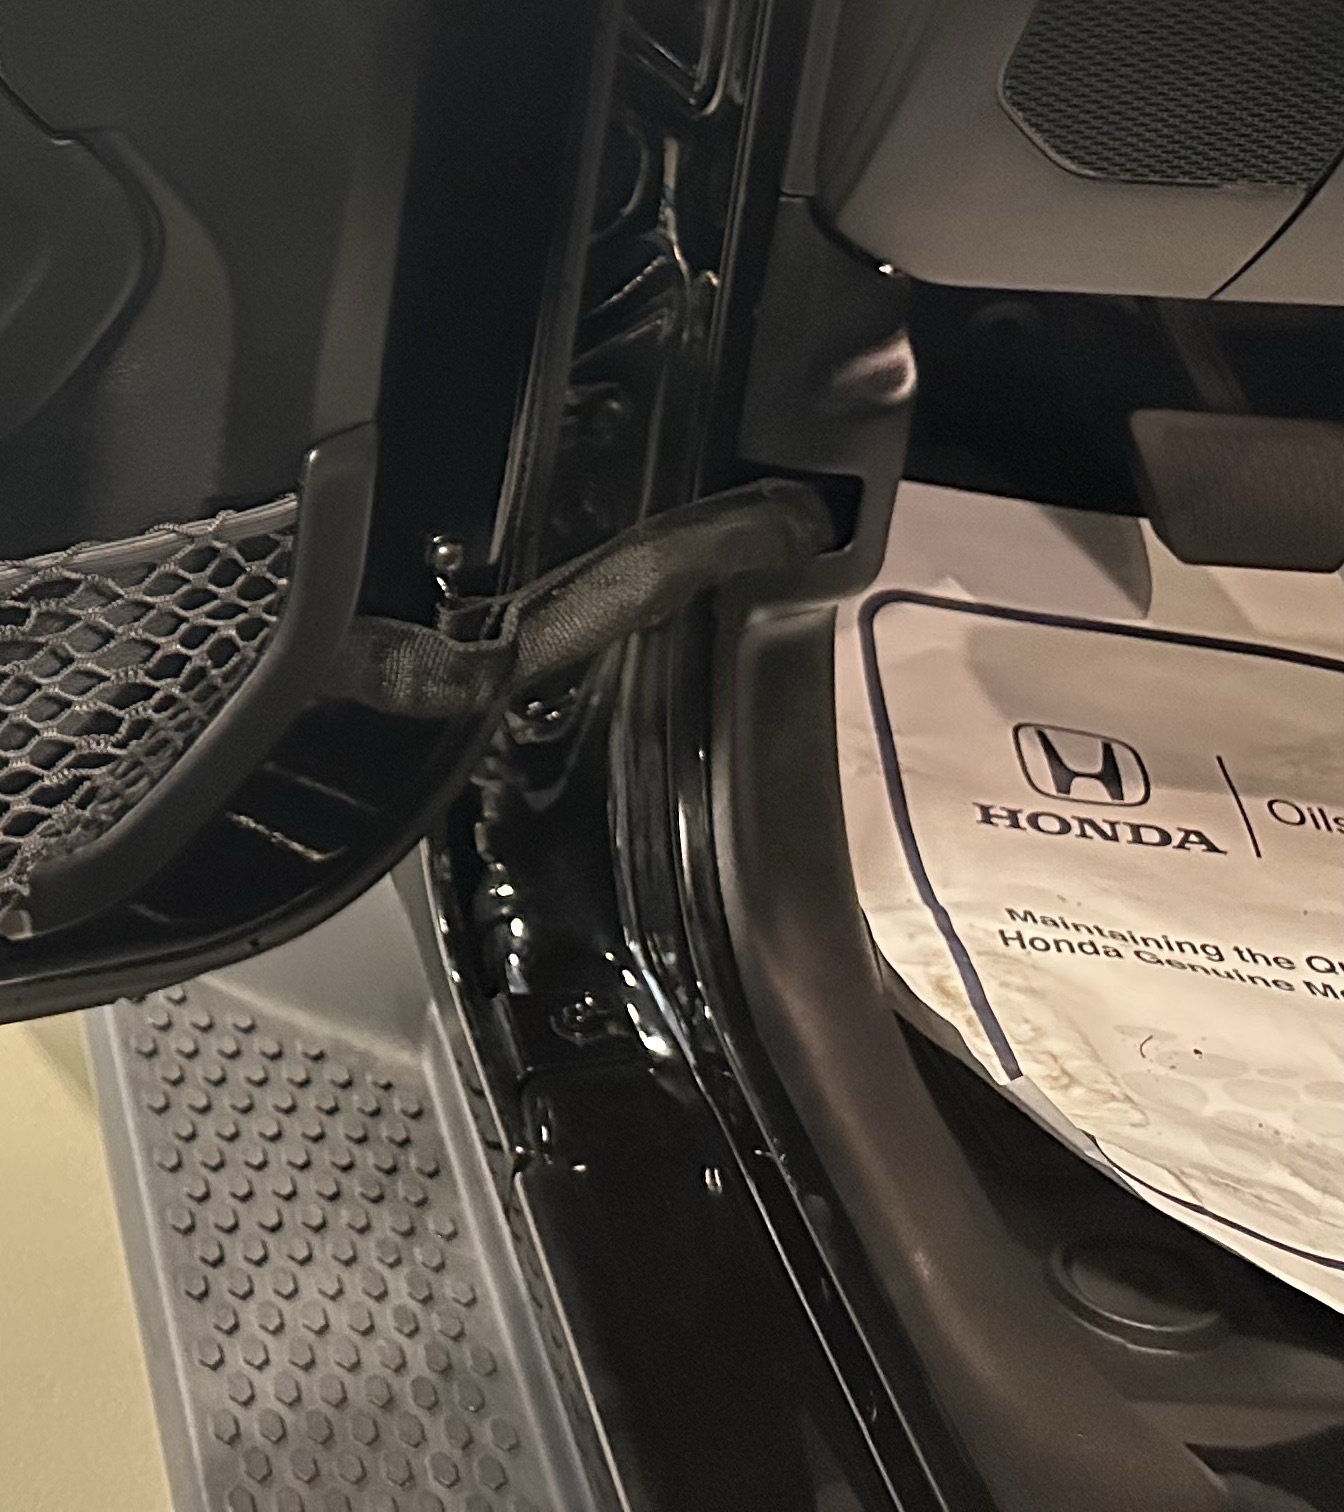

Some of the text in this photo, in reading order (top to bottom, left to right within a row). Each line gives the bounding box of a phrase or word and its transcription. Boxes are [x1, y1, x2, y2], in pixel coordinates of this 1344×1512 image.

[972, 801, 1228, 856] HONDA
[998, 928, 1124, 959] Honda
[1133, 949, 1296, 992] Genuine
[1004, 907, 1225, 962] Maintaining
[1232, 945, 1297, 971] the
